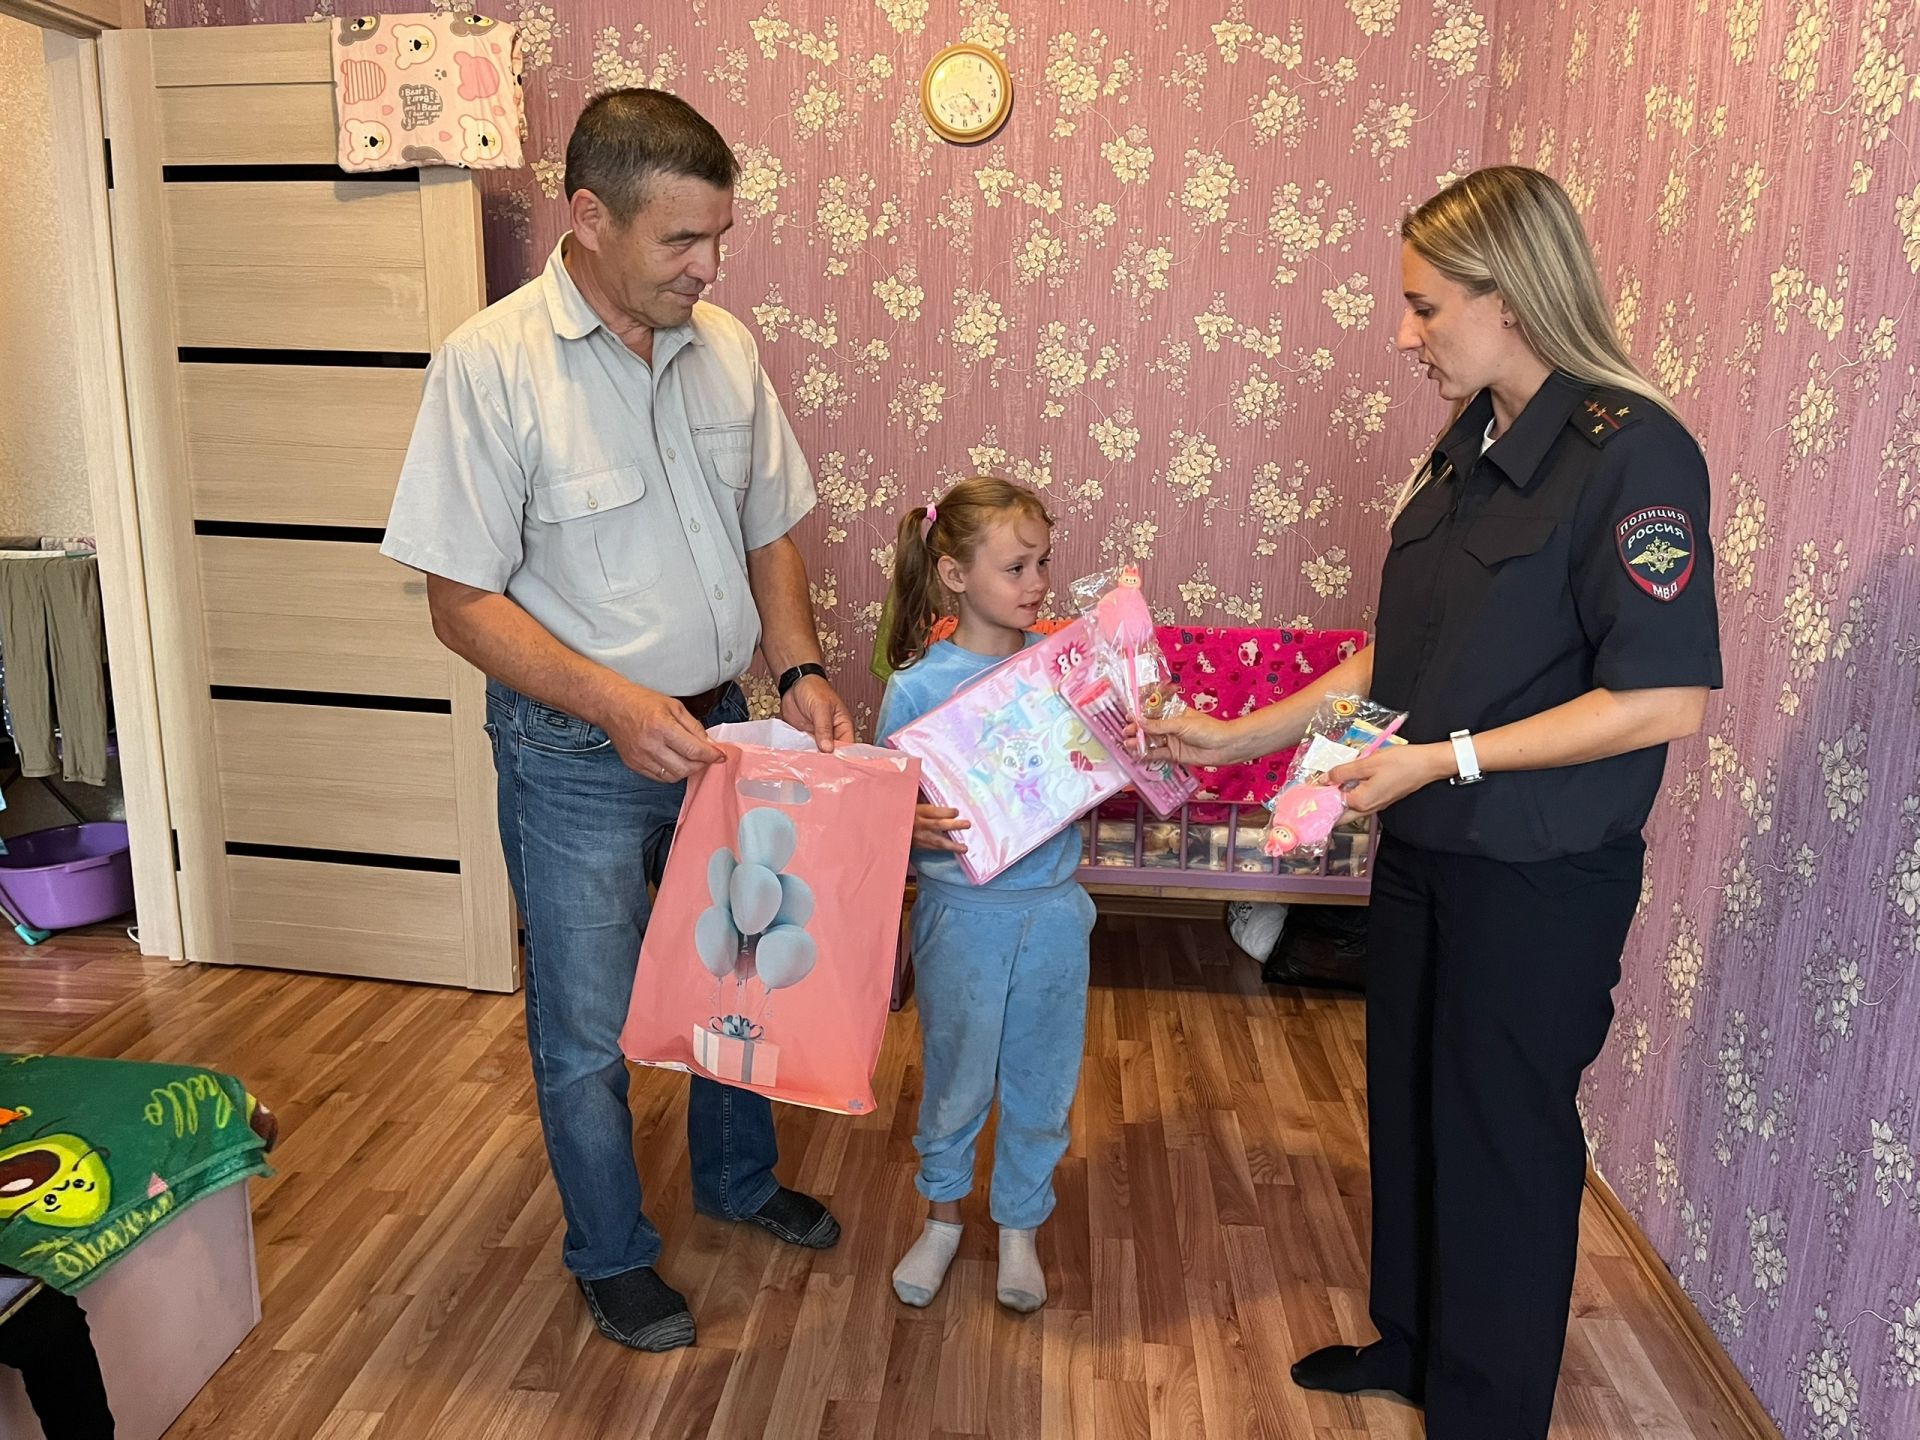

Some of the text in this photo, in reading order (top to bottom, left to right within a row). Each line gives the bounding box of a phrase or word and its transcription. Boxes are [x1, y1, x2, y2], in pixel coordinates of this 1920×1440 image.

[1620, 509, 1686, 535] ПОЛИЦИЯ
[1627, 523, 1685, 549] РОССИЯ
[1652, 582, 1678, 599] МВД
